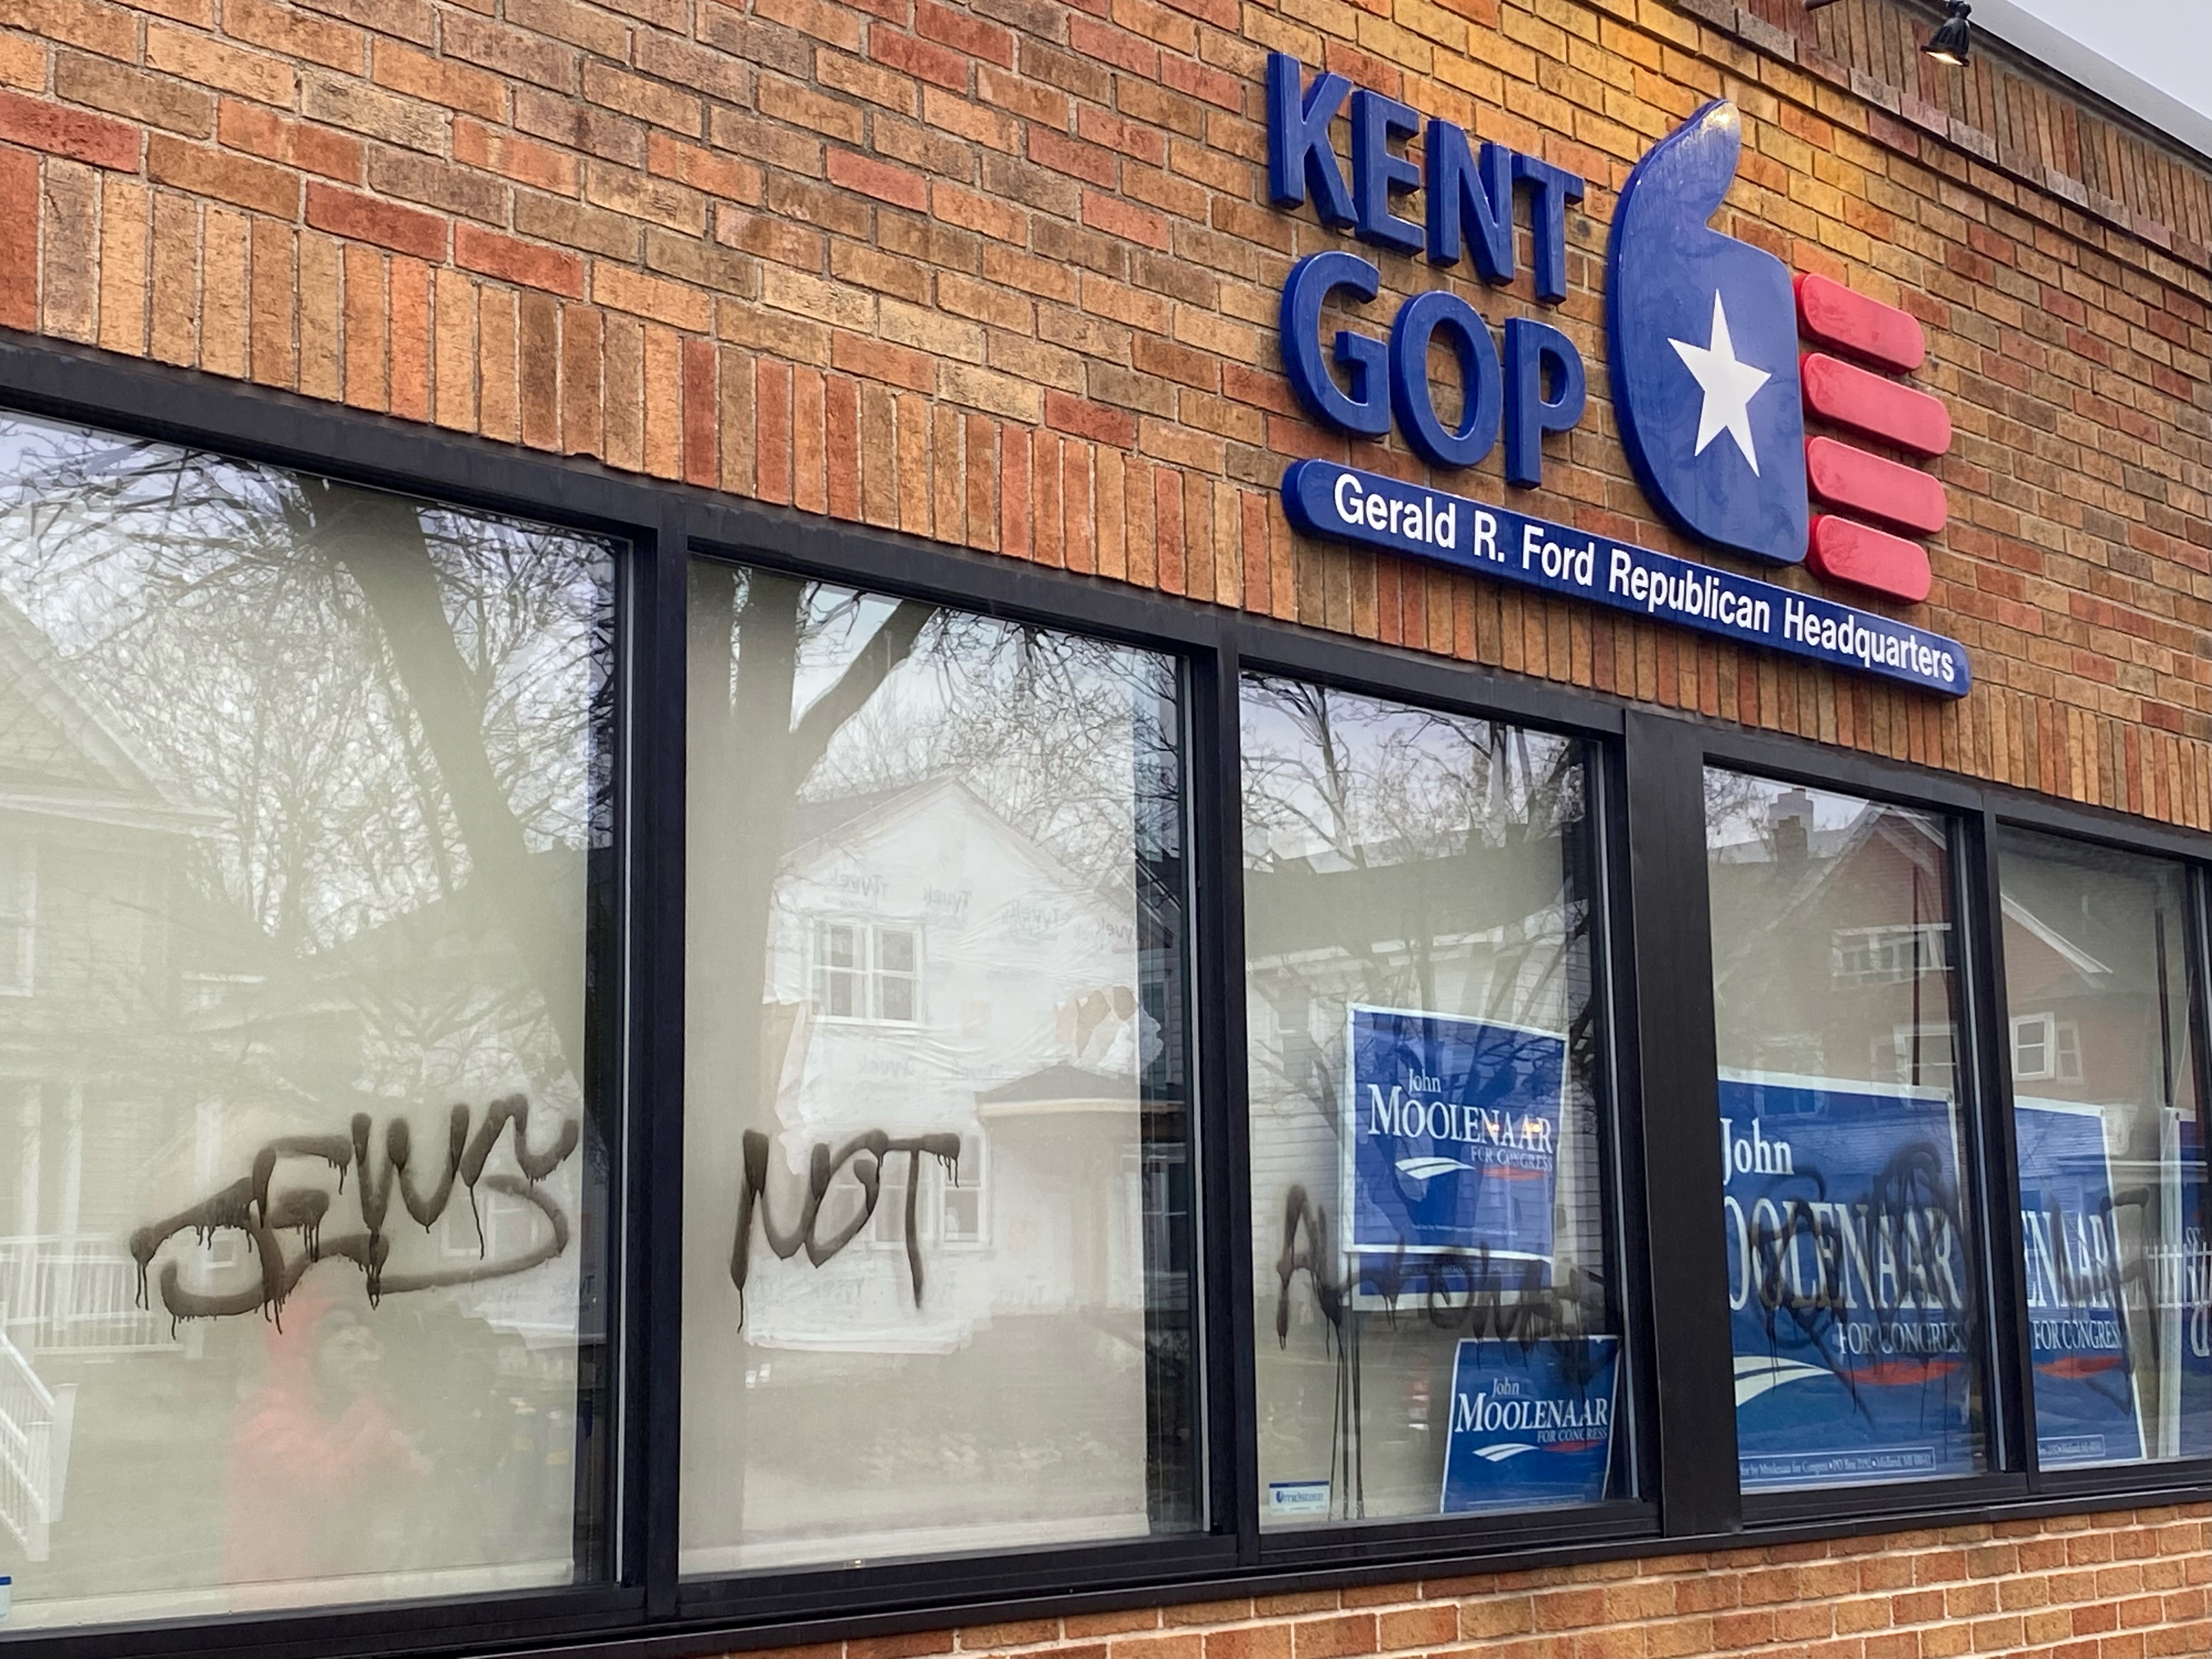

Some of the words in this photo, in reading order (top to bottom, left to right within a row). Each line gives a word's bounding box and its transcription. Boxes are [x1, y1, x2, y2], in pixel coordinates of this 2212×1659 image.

[1267, 52, 1584, 305] KENT
[1280, 250, 1587, 489] GOP
[1334, 473, 1455, 549] Gerald
[1474, 510, 1505, 563] R.
[1522, 524, 1595, 586] Ford
[1609, 548, 1770, 633] Republican
[1784, 597, 1955, 682] Headquarters
[1409, 1068, 1441, 1093] John
[1367, 1084, 1554, 1154] MOOLENAAR
[1719, 1117, 1795, 1186] John
[730, 1128, 961, 1317] NOT
[2033, 1320, 2062, 1350] FOR
[2062, 1319, 2124, 1350] CONGRES
[1454, 1392, 1608, 1433] MOOLENAAR
[1492, 1376, 1520, 1398] John
[1537, 1430, 1556, 1443] FOR
